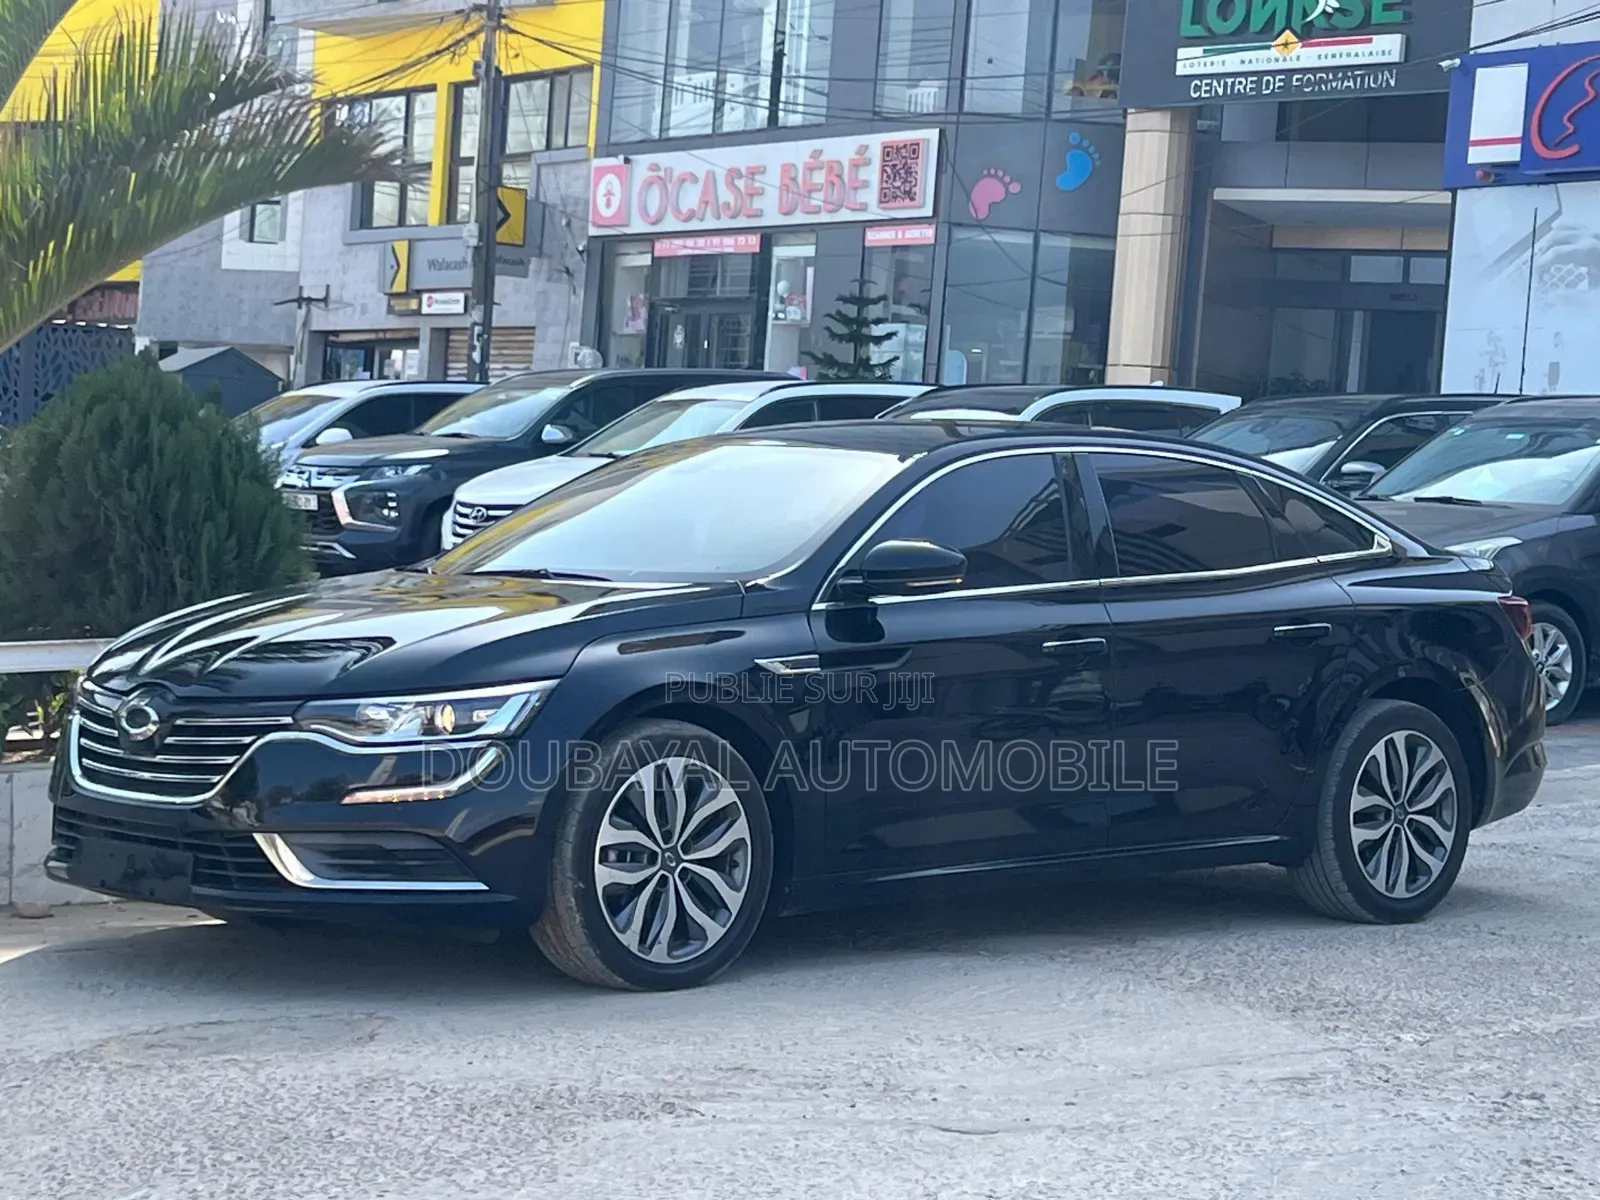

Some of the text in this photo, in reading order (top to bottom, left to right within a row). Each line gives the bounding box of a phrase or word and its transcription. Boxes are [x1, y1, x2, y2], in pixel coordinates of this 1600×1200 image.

[1182, 60, 1226, 69] LOTERIE
[1240, 55, 1302, 66] NATIONALE
[1190, 69, 1397, 98] CENTRE DE FORMATION
[779, 144, 871, 216] BÉBÉ
